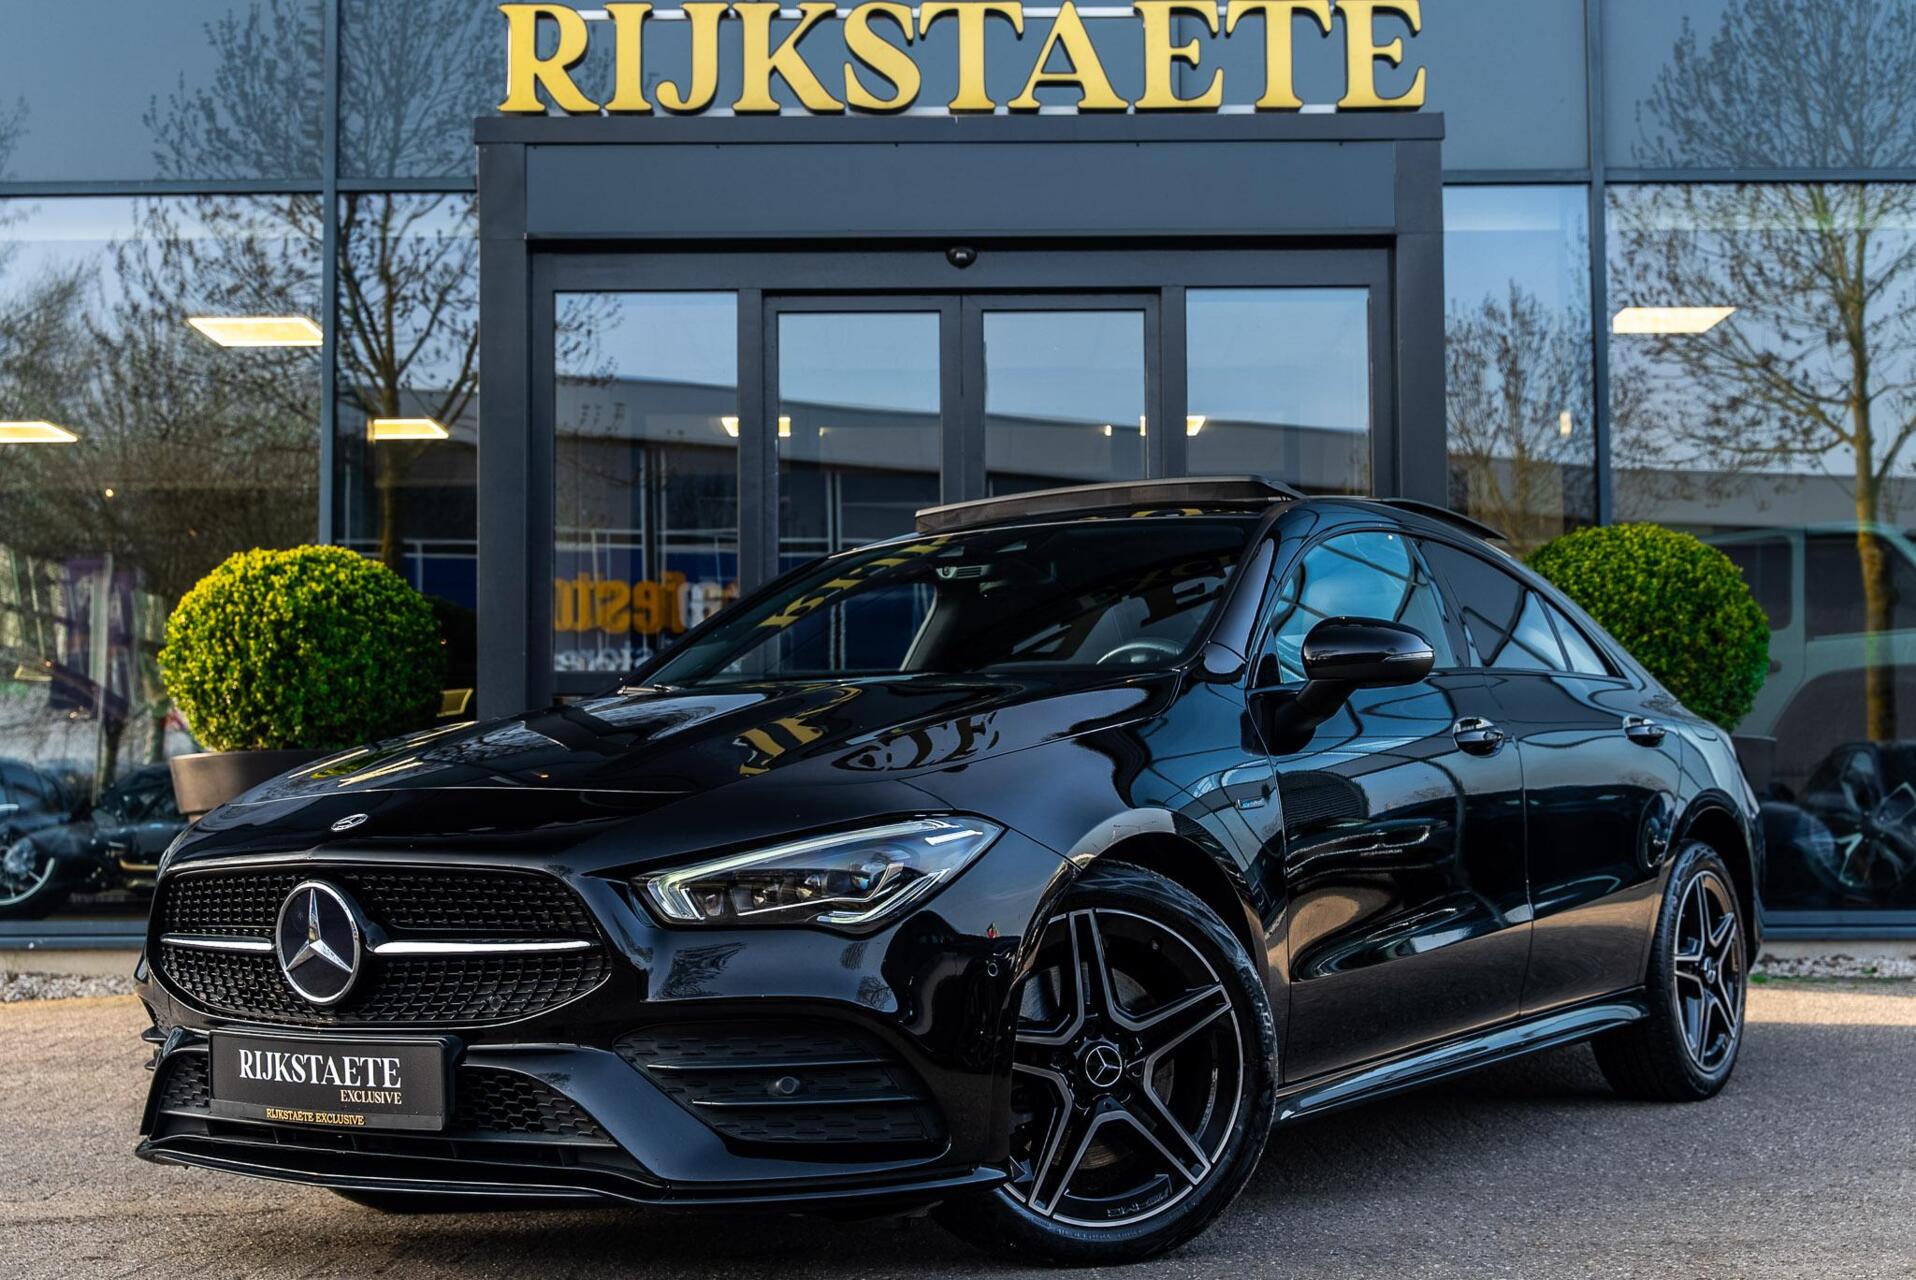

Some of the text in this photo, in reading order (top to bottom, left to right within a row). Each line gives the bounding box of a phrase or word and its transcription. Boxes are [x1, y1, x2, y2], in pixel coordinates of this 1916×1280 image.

[497, 0, 1427, 113] RIJKSTAETE
[238, 1049, 401, 1088] RIJKSTAETE
[340, 1089, 402, 1105] EXCLUSIVE
[266, 1108, 365, 1126] RIJKSTAETE EXCLUSIVE
